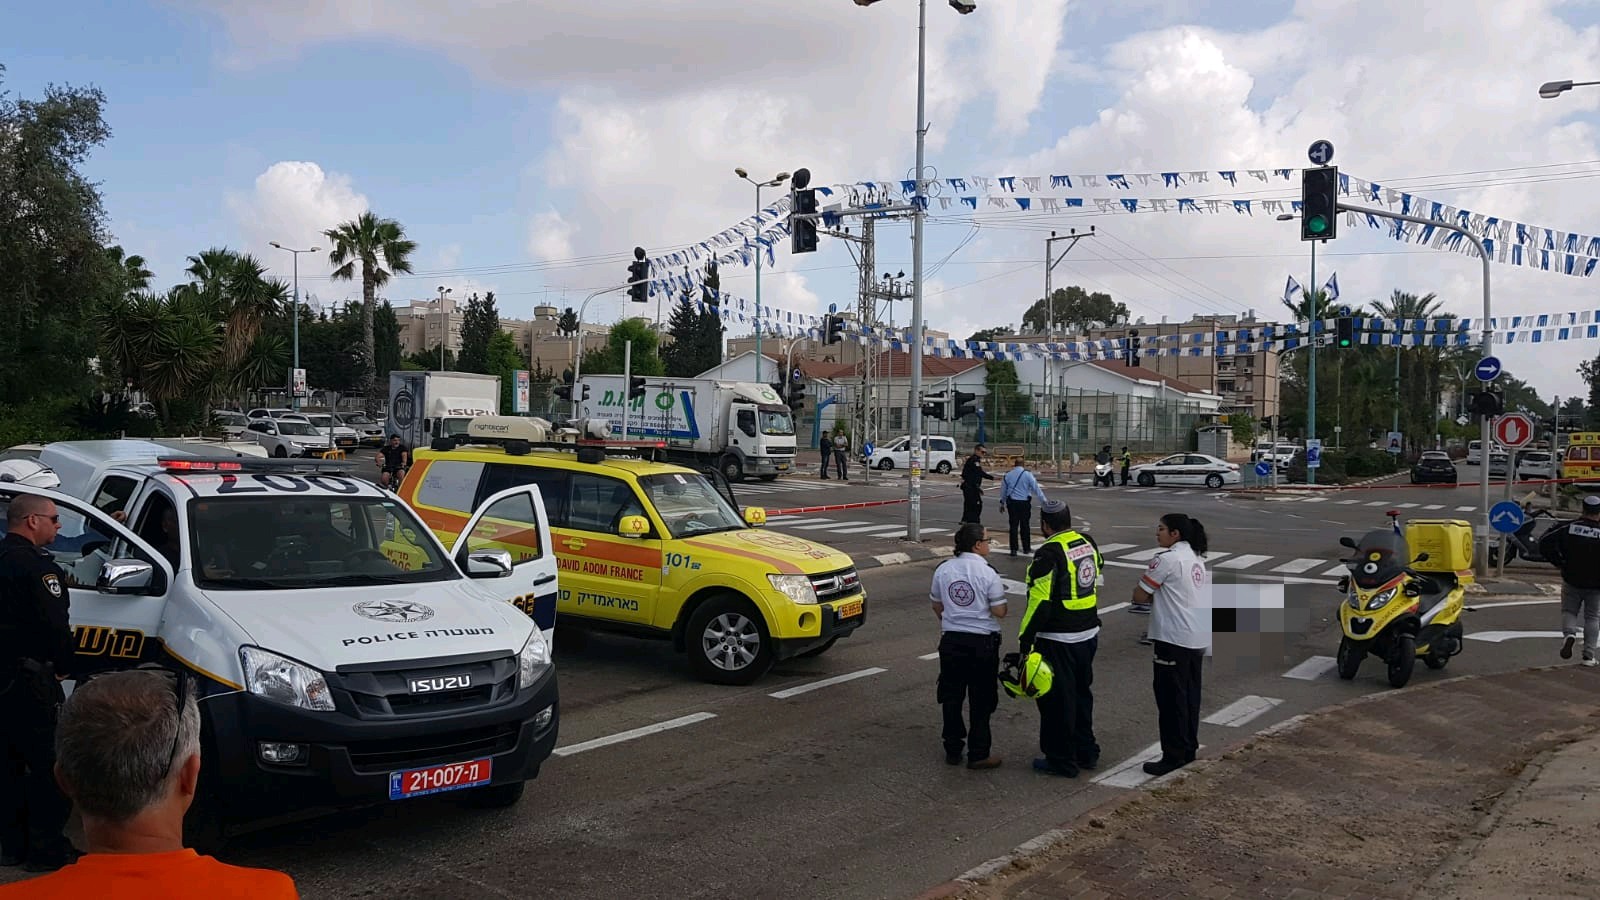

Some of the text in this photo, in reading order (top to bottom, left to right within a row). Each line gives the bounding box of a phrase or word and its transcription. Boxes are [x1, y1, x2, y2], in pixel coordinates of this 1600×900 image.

[556, 558, 580, 571] DAVID
[583, 561, 608, 576] ADOM
[610, 565, 644, 581] FRANCE
[665, 552, 691, 569] 101
[577, 591, 639, 612] פאראמדיק
[342, 627, 495, 647] POLICE משטרה
[411, 675, 470, 693] ISUZU
